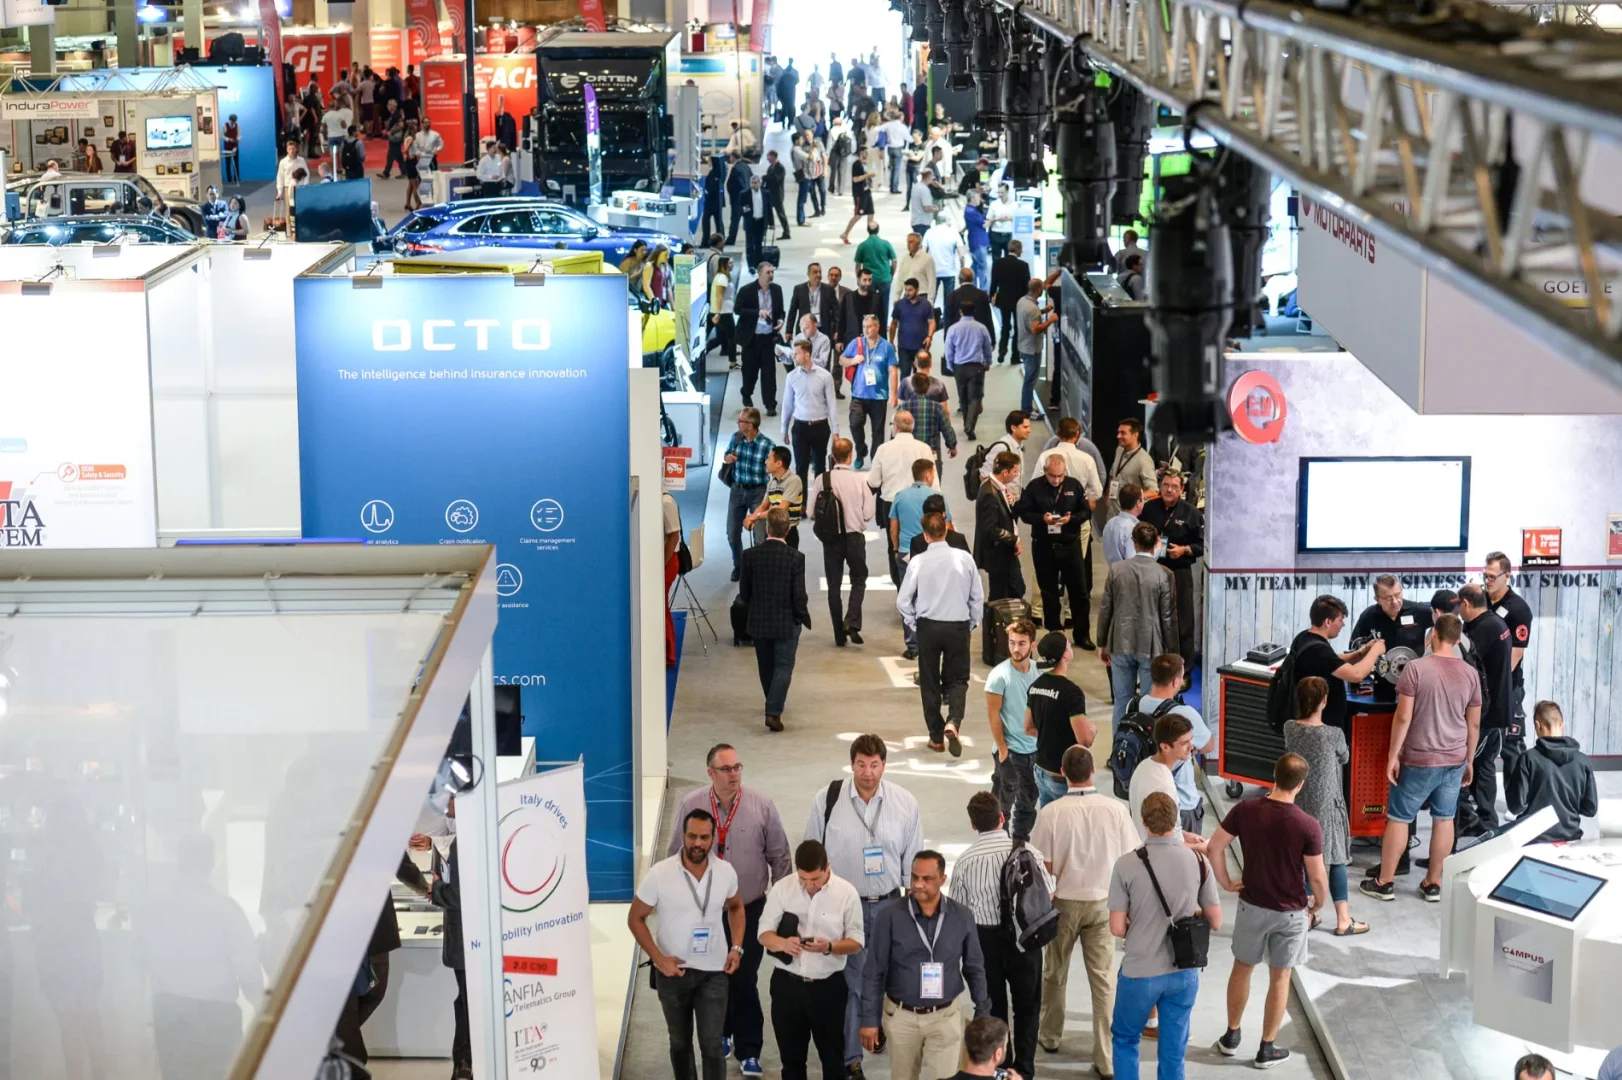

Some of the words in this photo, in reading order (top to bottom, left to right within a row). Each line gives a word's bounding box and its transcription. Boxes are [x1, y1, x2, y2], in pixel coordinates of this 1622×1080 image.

[585, 75, 638, 83] ORTEN
[5, 101, 89, 111] InduraPower
[1313, 201, 1376, 264] MOTORPARTS
[1543, 280, 1613, 294] GOETE
[372, 319, 551, 351] OCTO
[338, 369, 358, 380] The
[361, 369, 427, 382] intelligence
[429, 369, 468, 380] behind
[471, 368, 525, 379] insurance
[528, 367, 587, 378] innovation
[539, 537, 576, 545] management
[1224, 576, 1250, 590] MY
[1256, 575, 1307, 590] TEAM
[1342, 575, 1370, 590] MY
[1400, 574, 1467, 589] SINESS
[1539, 573, 1600, 588] STOCK
[520, 793, 543, 807] Italy
[544, 799, 569, 829] drives
[502, 926, 532, 941] obility
[535, 911, 584, 932] innovation
[1502, 946, 1545, 964] CAMPUS
[504, 981, 544, 1004] ANFIA
[514, 994, 552, 1012] Telematics
[553, 988, 576, 1000] Group
